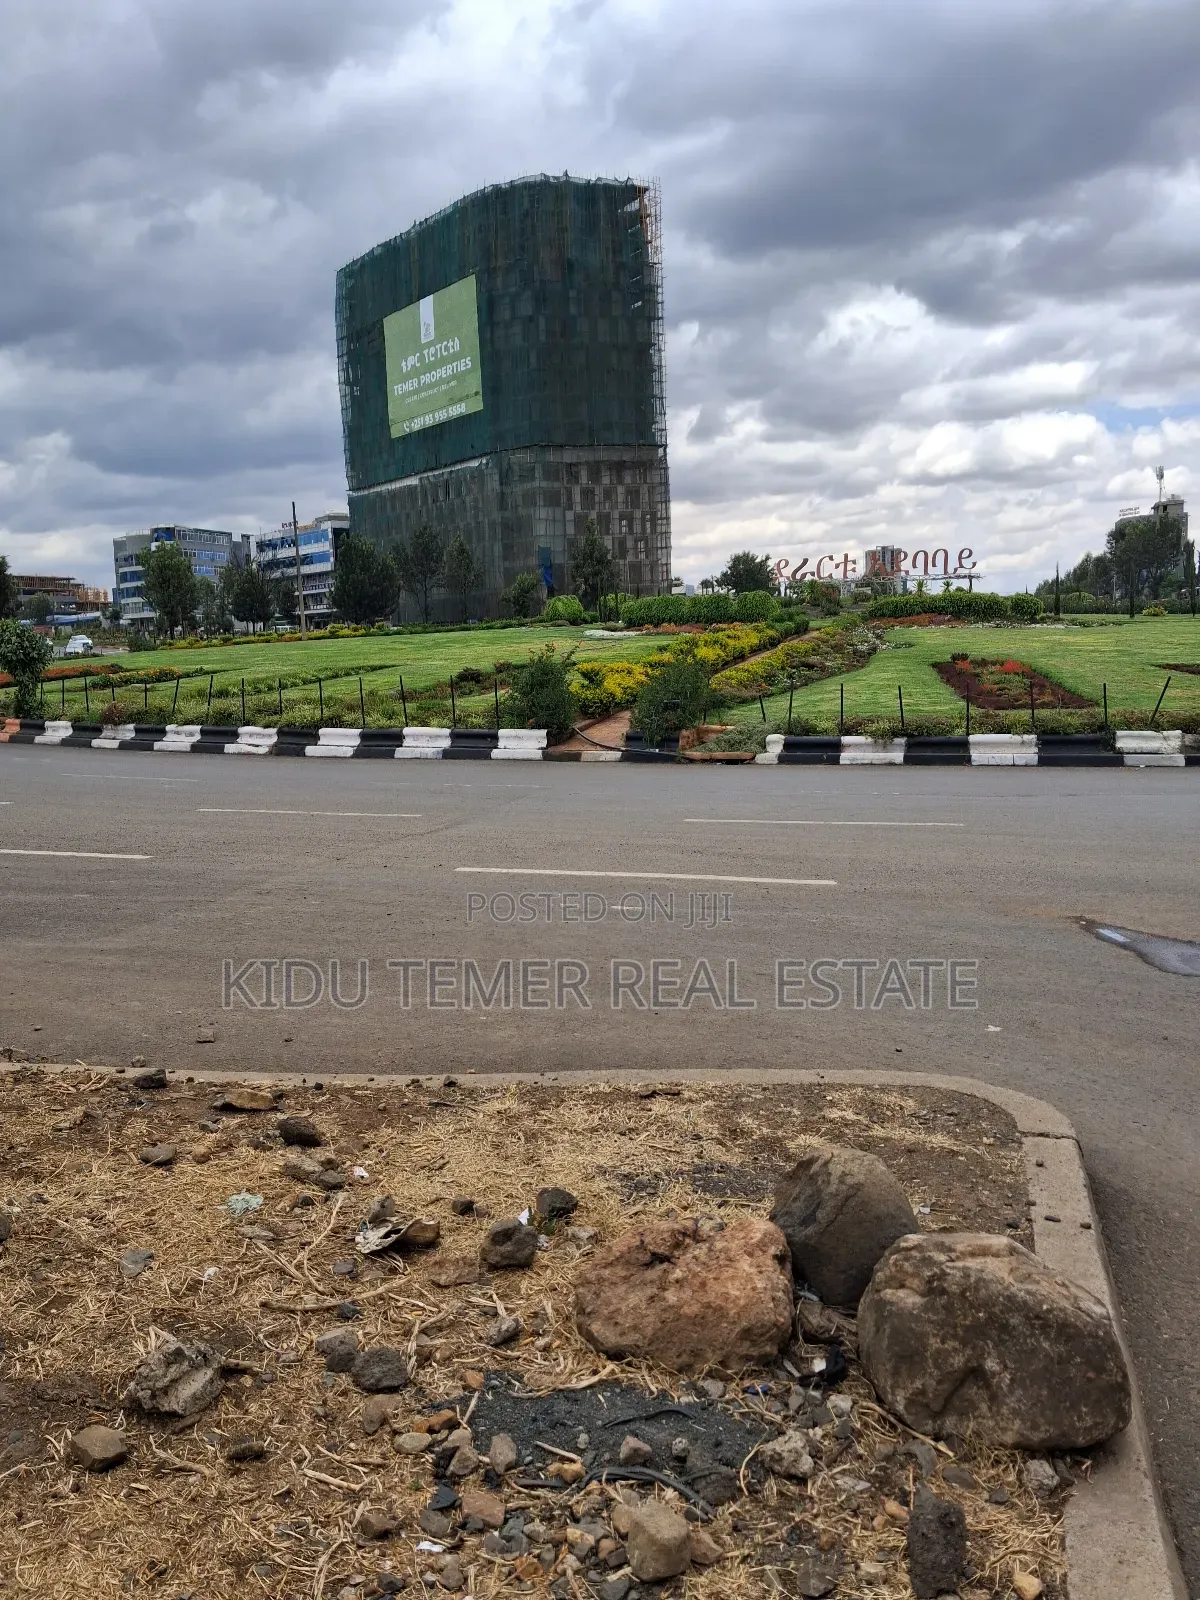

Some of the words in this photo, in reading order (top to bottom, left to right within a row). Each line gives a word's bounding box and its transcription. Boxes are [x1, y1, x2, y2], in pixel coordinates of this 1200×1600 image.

[393, 377, 418, 396] TEMER
[420, 356, 472, 387] PROPERTIES
[424, 413, 432, 425] 93
[434, 409, 447, 421] 955
